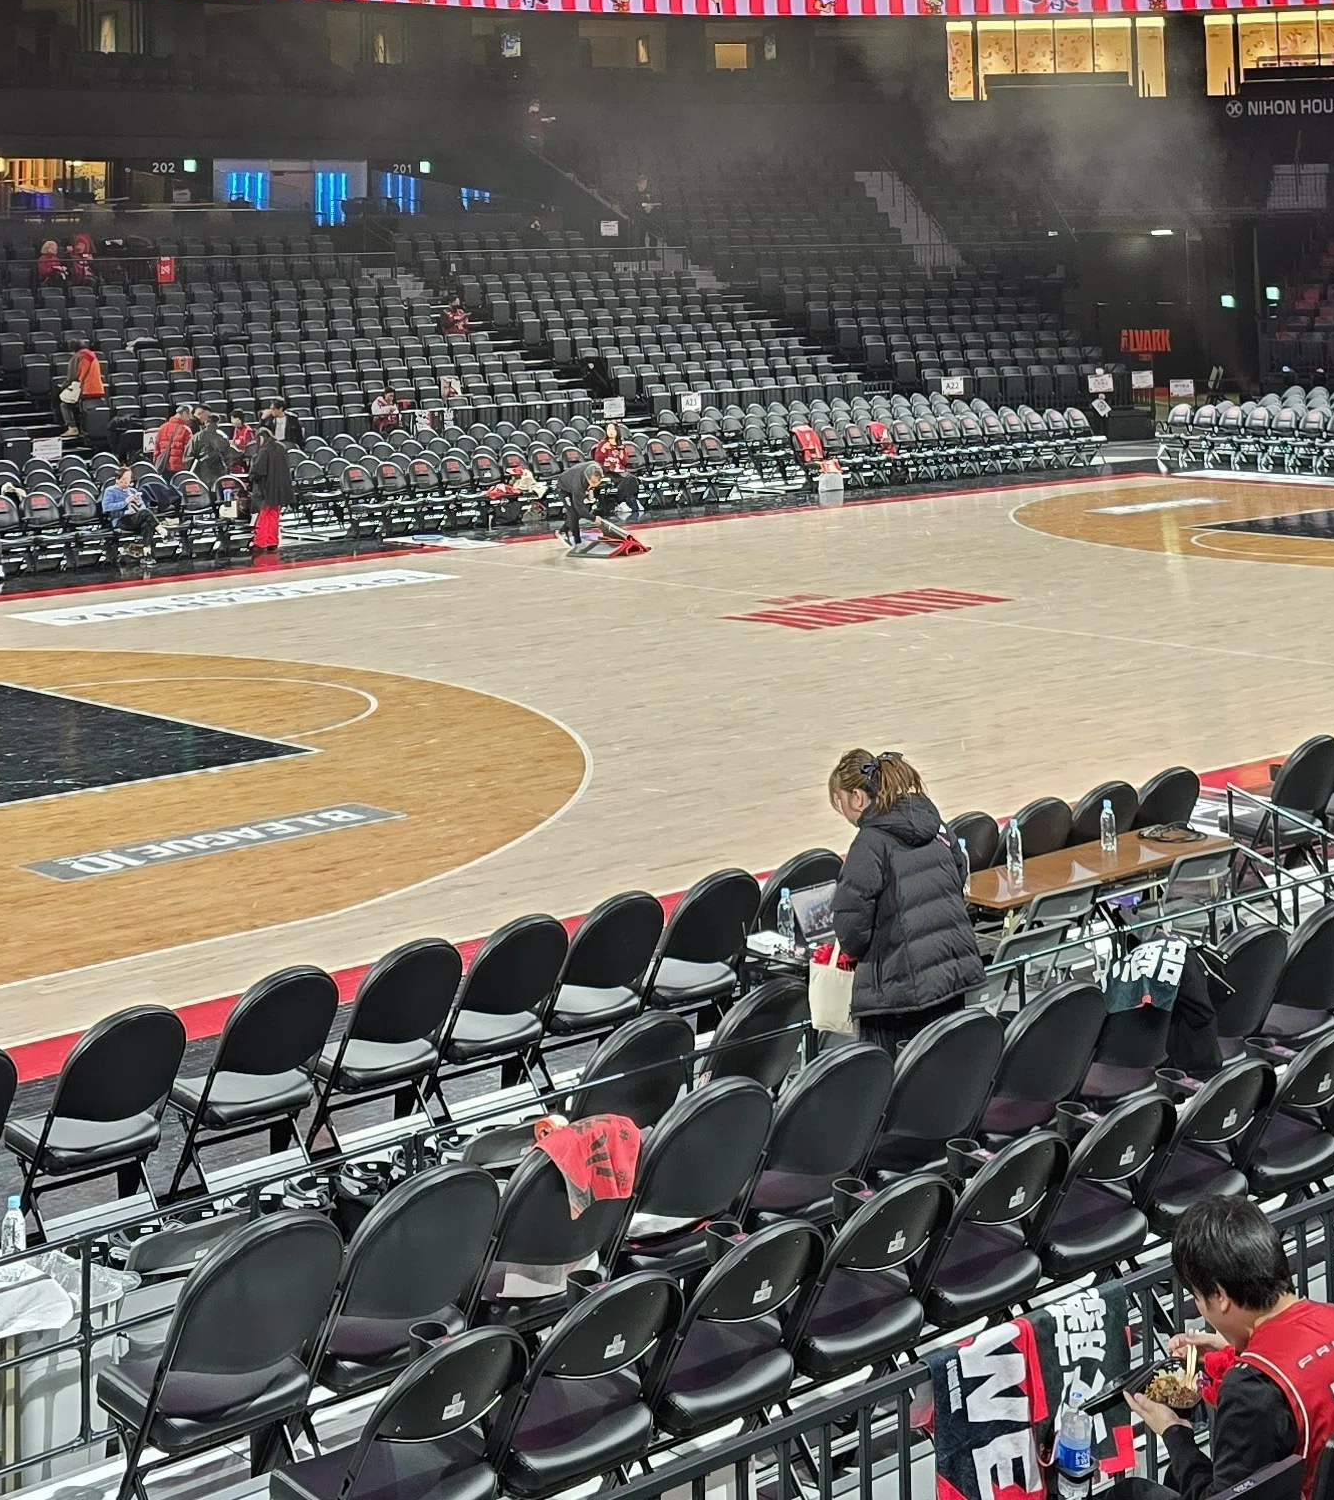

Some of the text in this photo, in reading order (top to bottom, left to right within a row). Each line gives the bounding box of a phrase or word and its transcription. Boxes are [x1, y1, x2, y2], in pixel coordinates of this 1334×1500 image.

[1247, 99, 1296, 116] NIHON
[152, 161, 176, 174] 202
[393, 163, 412, 174] 201
[945, 382, 959, 390] A22
[51, 592, 241, 625] ARENA
[125, 808, 366, 860] B.LEAGUE
